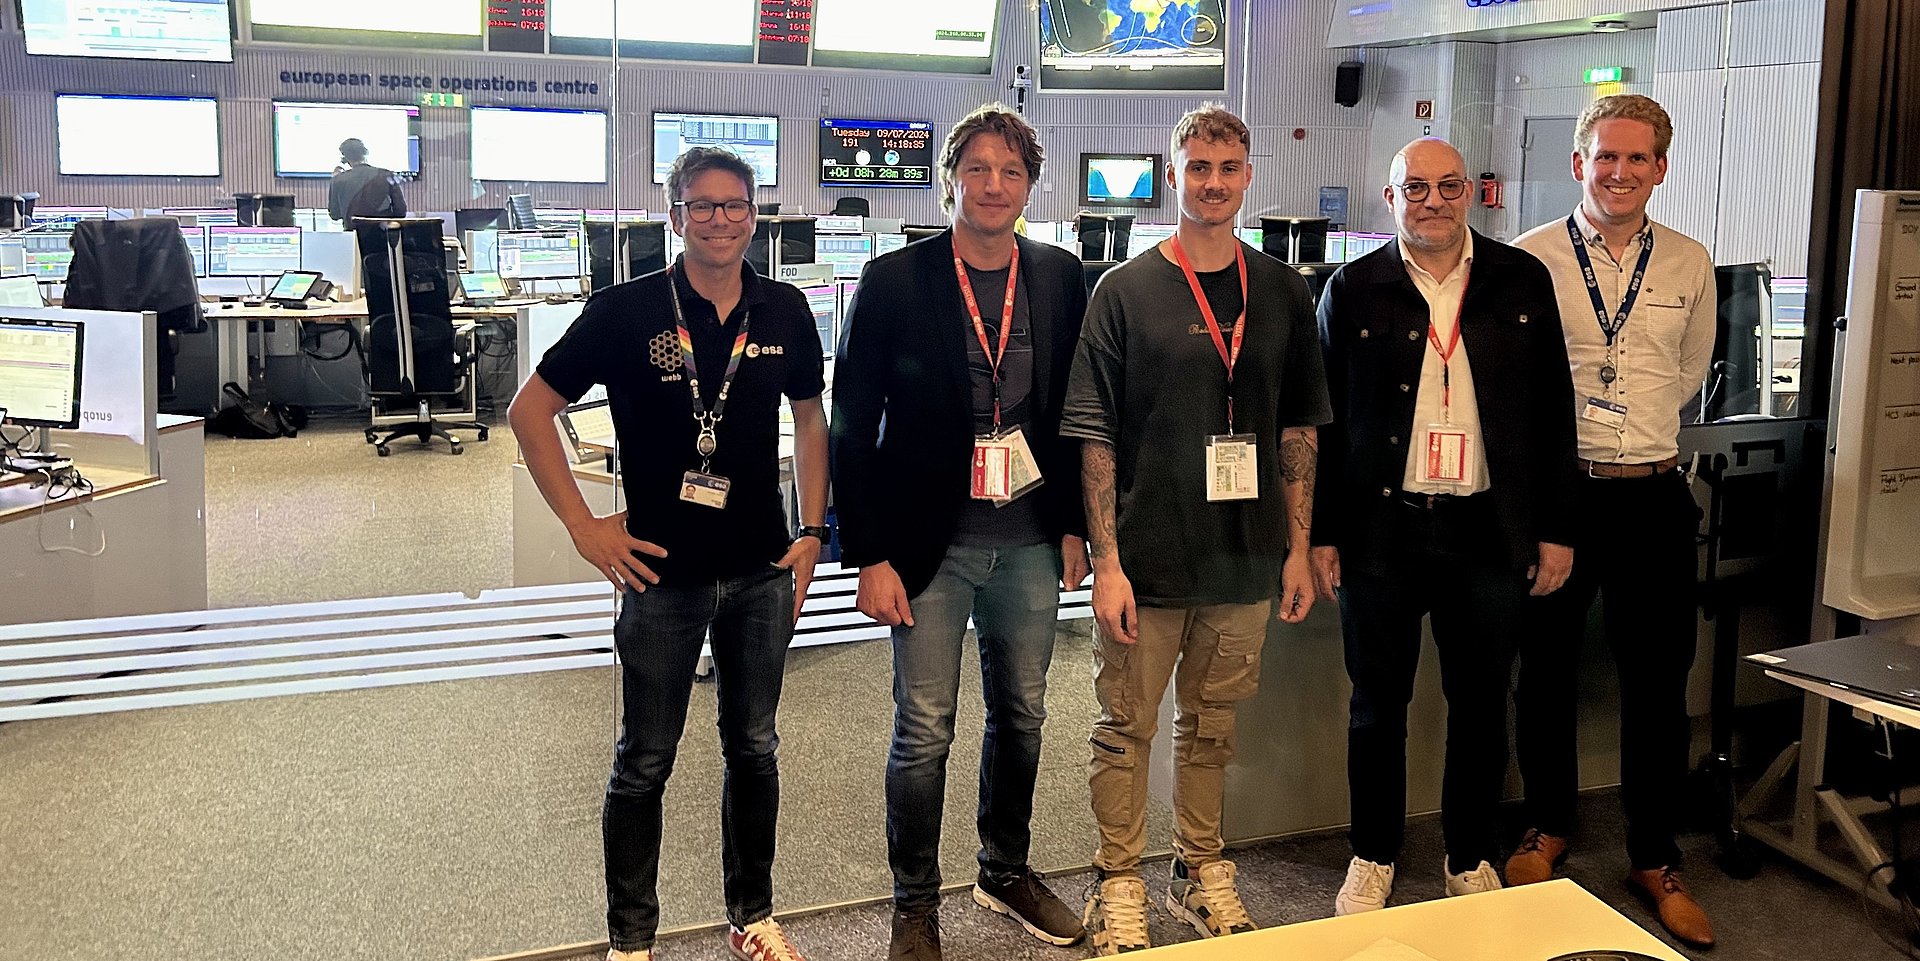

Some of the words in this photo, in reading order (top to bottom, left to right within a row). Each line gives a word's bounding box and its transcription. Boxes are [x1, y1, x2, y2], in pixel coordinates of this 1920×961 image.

[279, 69, 371, 88] european
[379, 73, 432, 90] space
[439, 75, 537, 93] operations
[544, 80, 599, 95] centre
[831, 128, 870, 137] Tuesday
[877, 129, 930, 140] 09/07/2024
[842, 138, 859, 147] 191
[781, 267, 798, 277] FOD
[761, 345, 784, 355] esa
[661, 373, 682, 382] webb
